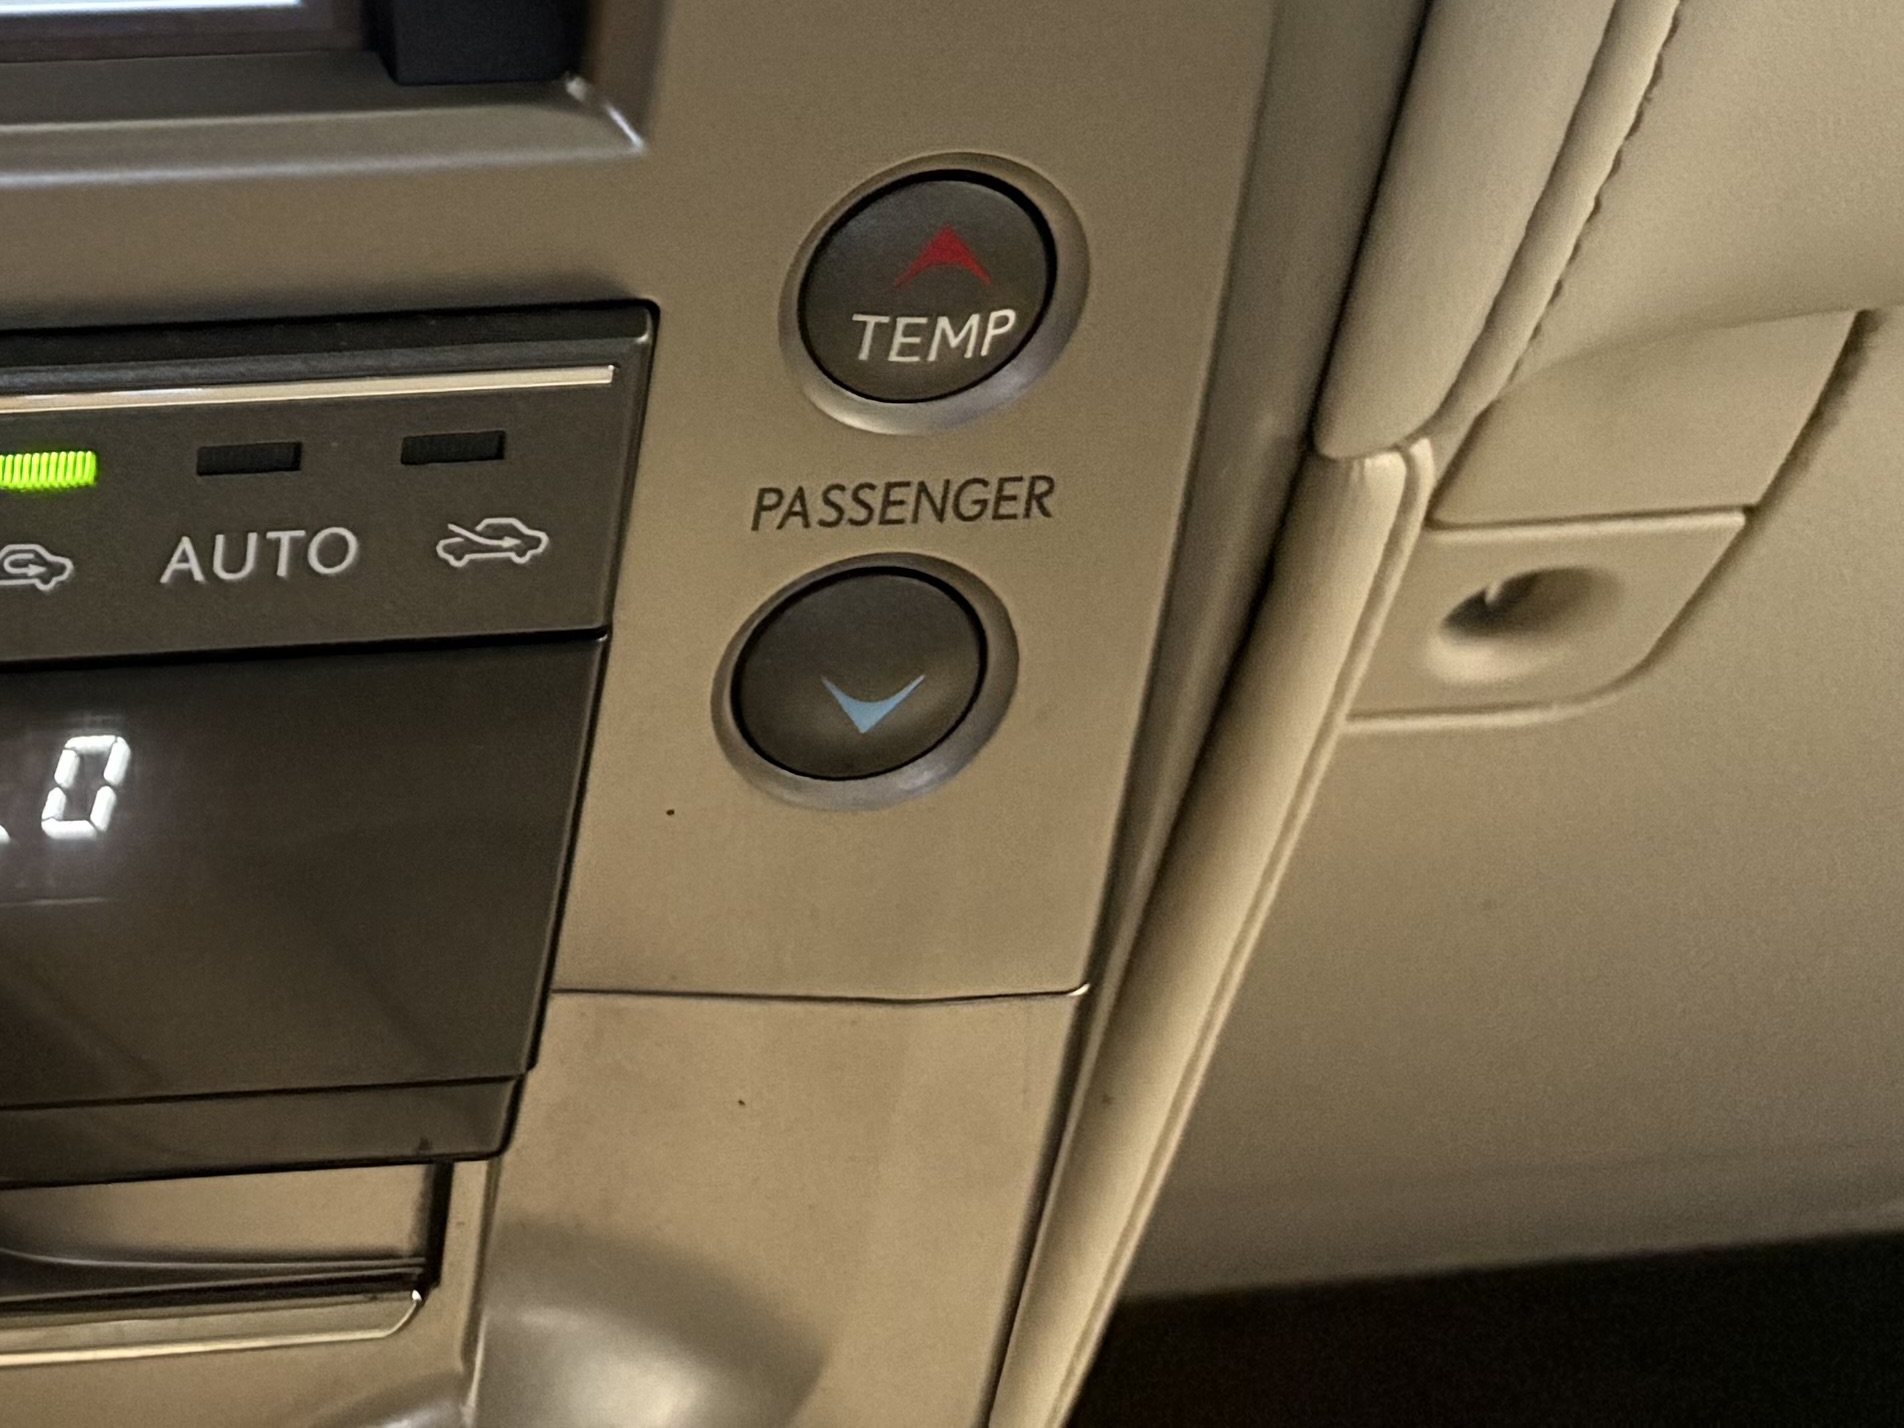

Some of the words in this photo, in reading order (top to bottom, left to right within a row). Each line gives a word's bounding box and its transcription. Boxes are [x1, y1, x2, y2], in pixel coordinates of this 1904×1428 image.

[851, 306, 1017, 365] TEMP
[750, 473, 1057, 533] PASSENGER
[159, 525, 360, 585] AUTO
